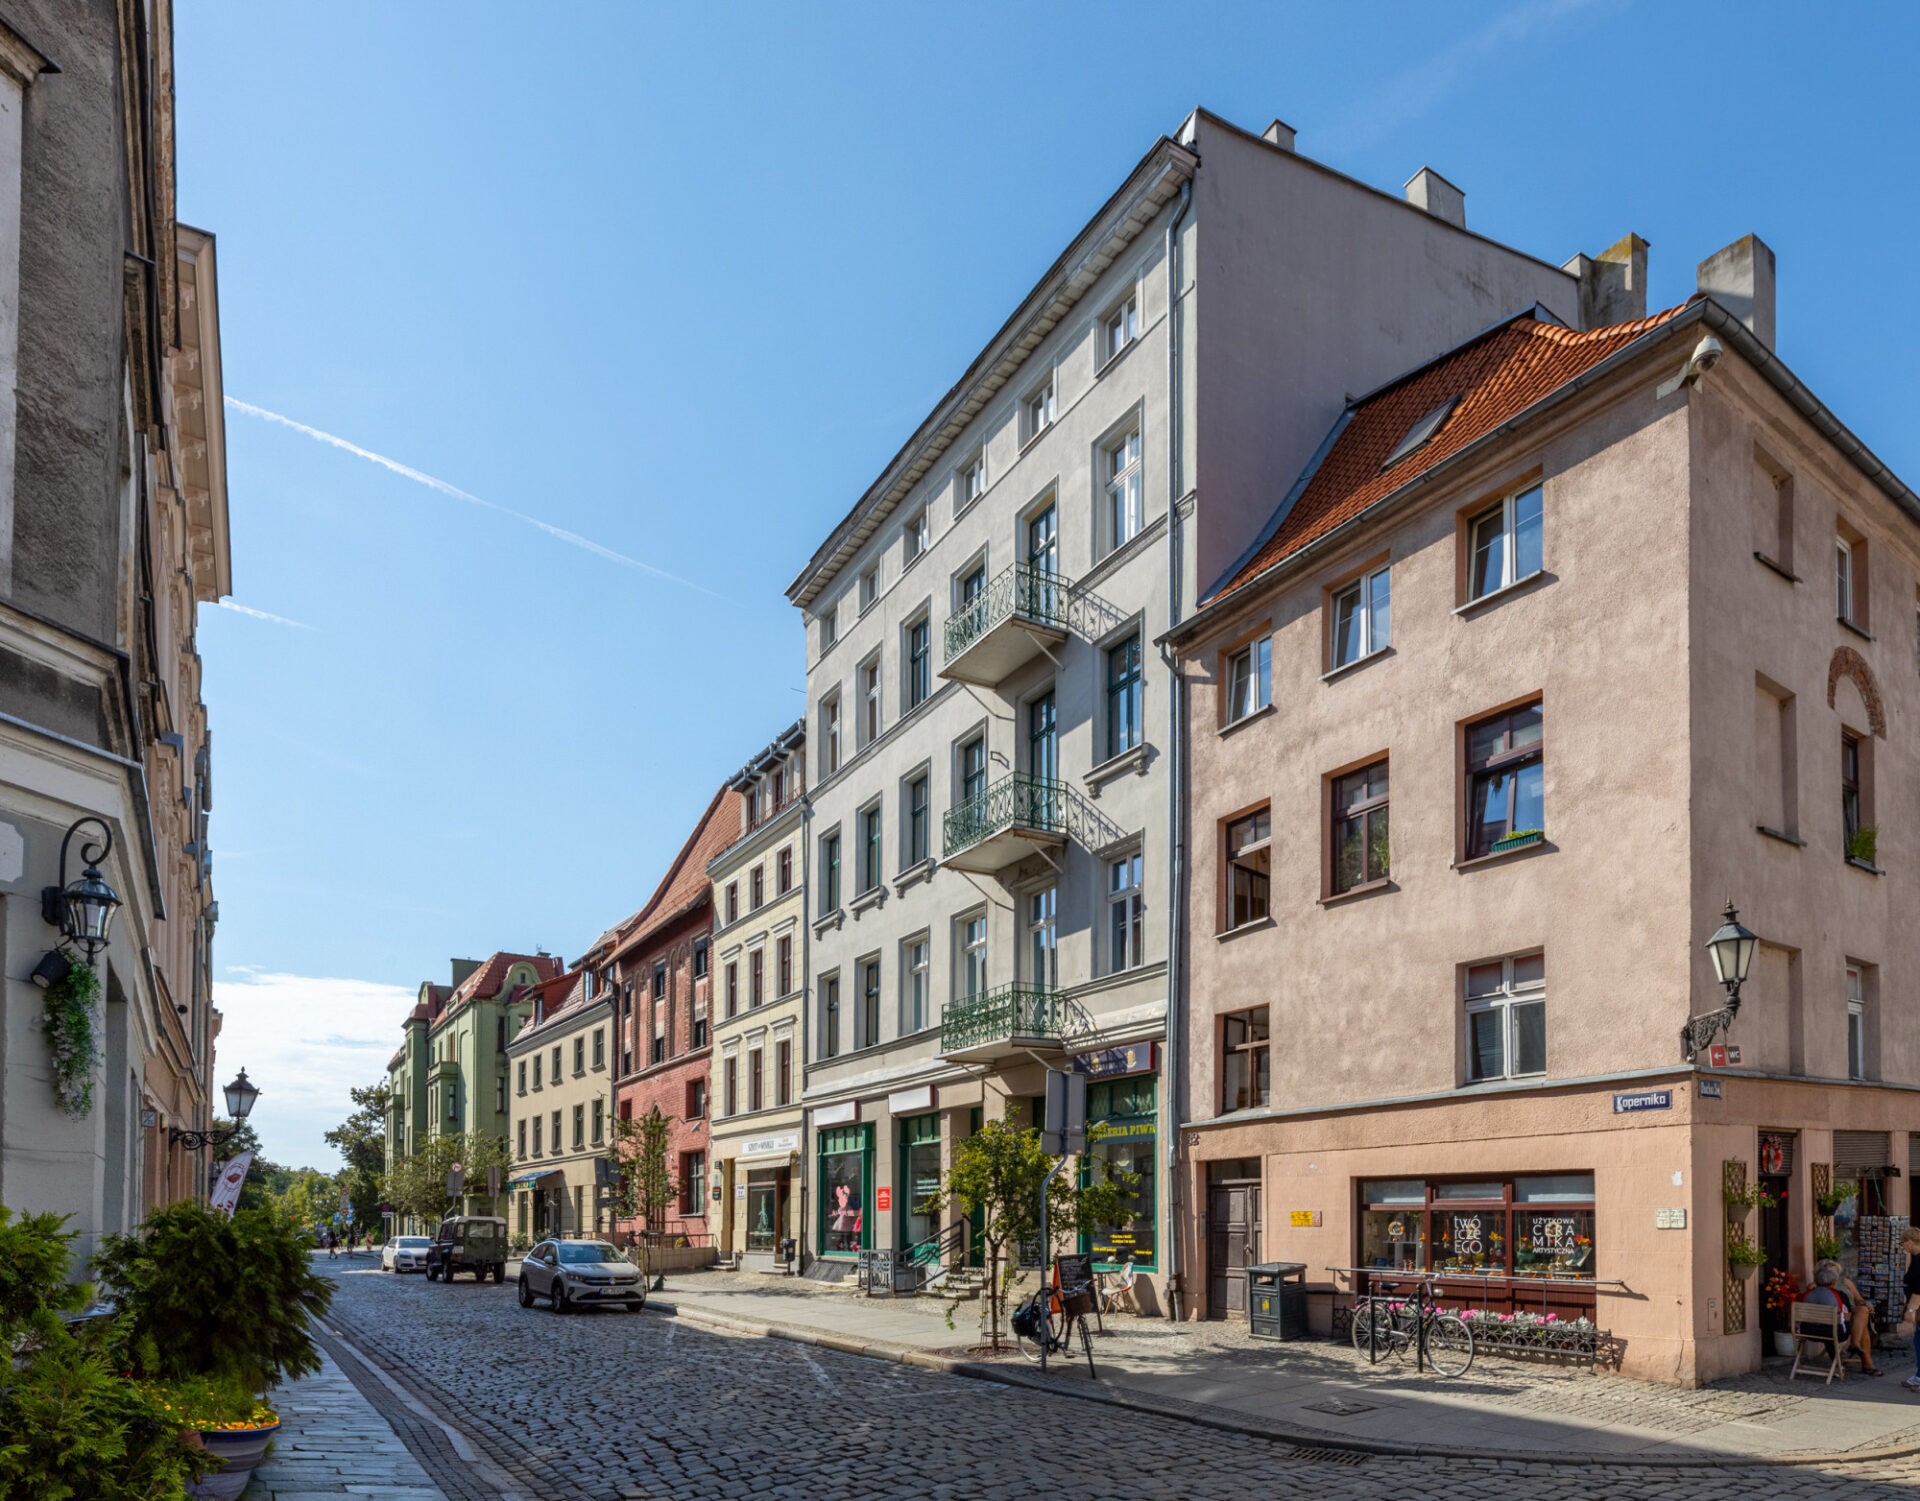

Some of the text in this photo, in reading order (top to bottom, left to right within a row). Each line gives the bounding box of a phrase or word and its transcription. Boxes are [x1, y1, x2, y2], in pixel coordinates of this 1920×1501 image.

[1730, 1050, 1740, 1058] WC
[1617, 1093, 1666, 1112] Kopernika
[1130, 1123, 1155, 1136] PIWA
[1454, 1215, 1481, 1230] twó
[1533, 1217, 1575, 1225] UŻYTKOWA
[1454, 1229, 1481, 1240] rcze
[1533, 1225, 1575, 1236] CERA
[1454, 1240, 1482, 1254] EGO
[1533, 1236, 1575, 1247] MIKA
[1533, 1247, 1575, 1255] ARTYSTYCZNA
